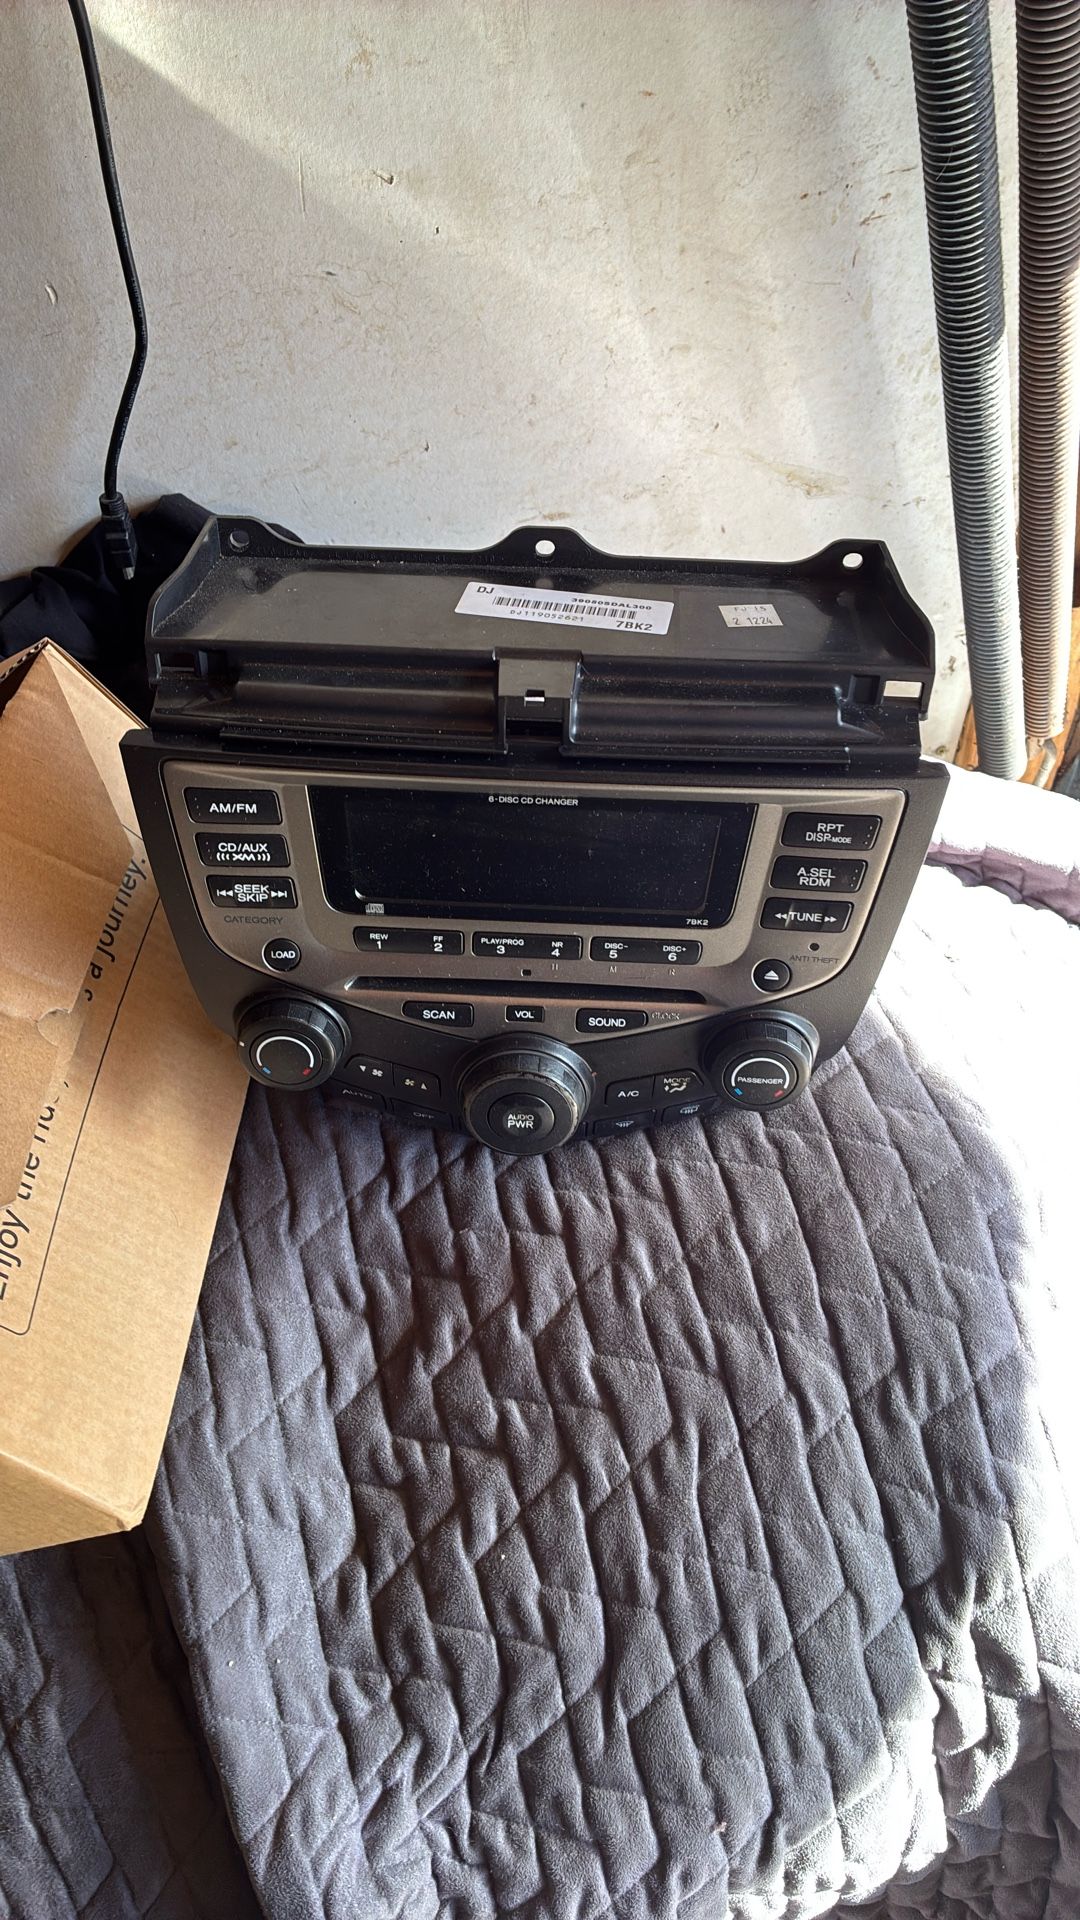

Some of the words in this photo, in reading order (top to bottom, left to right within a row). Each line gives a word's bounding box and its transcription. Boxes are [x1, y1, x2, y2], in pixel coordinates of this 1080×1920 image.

[477, 586, 493, 595] DJ
[616, 620, 653, 632] 7BK2
[520, 796, 534, 805] CD
[535, 797, 579, 807] CHANGER
[209, 803, 257, 814] AM/FM
[817, 823, 845, 833] RPT
[218, 842, 268, 853] CD/AUX
[797, 867, 836, 879] A.SEL
[799, 877, 831, 887] RDM
[234, 884, 269, 894] SEEK
[237, 893, 269, 903] SKIP
[223, 915, 283, 925] CATEGORY
[686, 918, 709, 926] 7BK2
[789, 911, 822, 923] TUNE
[369, 933, 389, 941] REW
[480, 937, 525, 947] PLAY/PROG
[376, 941, 382, 950] 1
[433, 943, 443, 952] 2
[496, 945, 506, 955] 3
[551, 941, 564, 949] NR
[271, 950, 296, 959] LOAD
[551, 949, 561, 958] 4
[608, 950, 618, 959] 5
[667, 952, 677, 962] 6
[422, 1009, 456, 1020] SCAN
[514, 1010, 535, 1019] VOL
[588, 1017, 627, 1028] SOUND
[737, 1076, 784, 1085] PASSENGER
[617, 1090, 640, 1098] A/C
[507, 1113, 535, 1121] AUDIO
[507, 1120, 534, 1129] PWR
